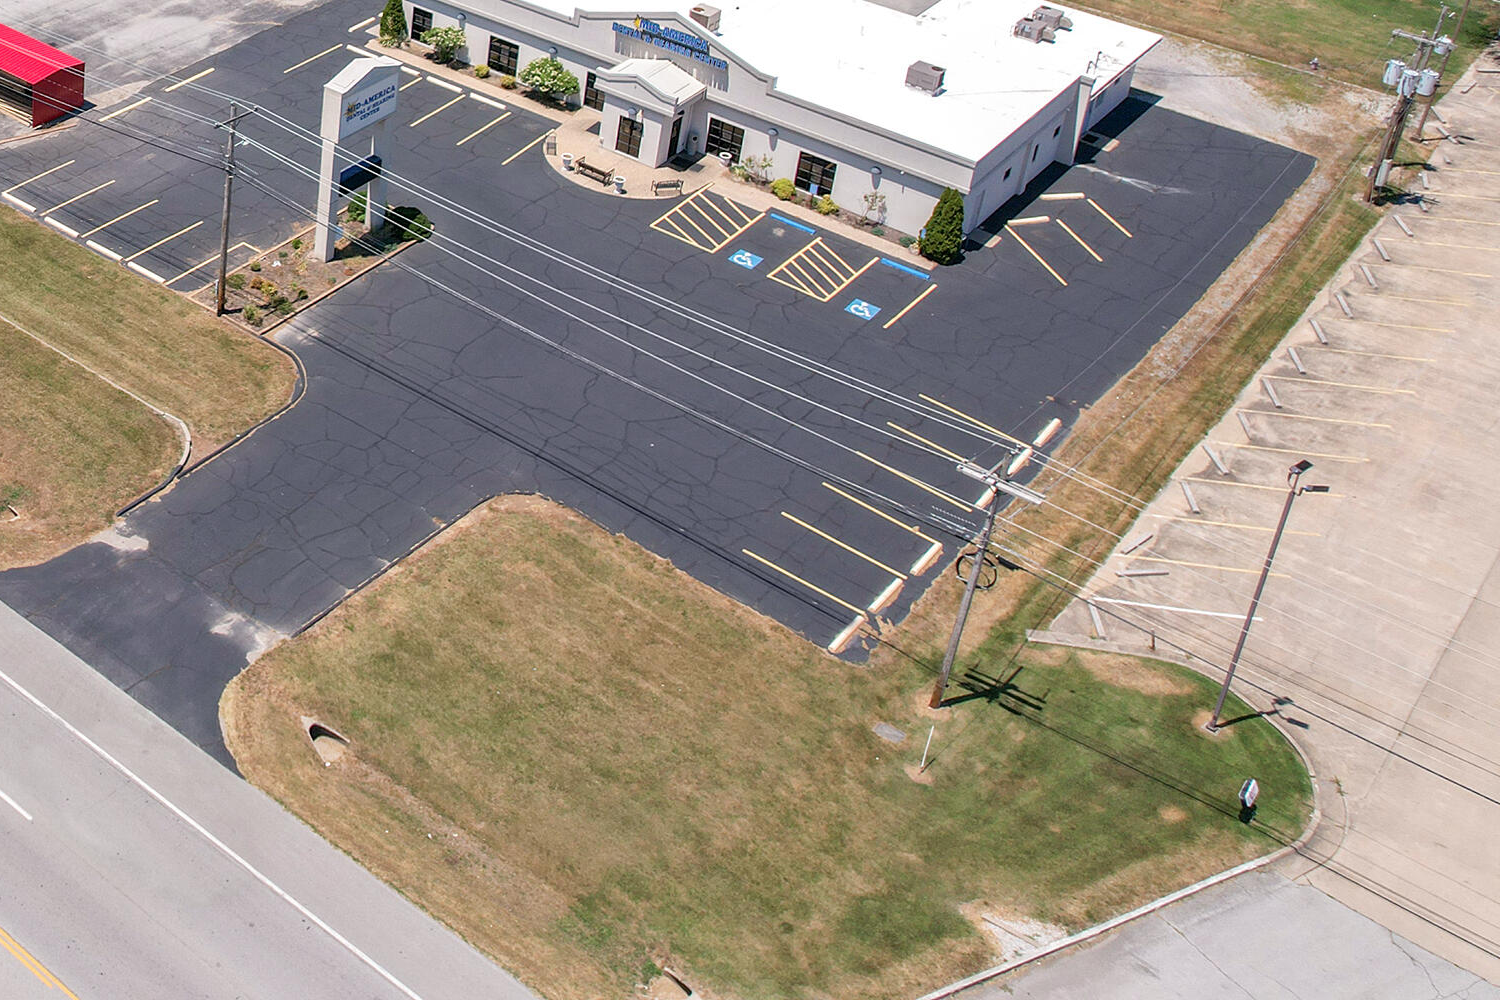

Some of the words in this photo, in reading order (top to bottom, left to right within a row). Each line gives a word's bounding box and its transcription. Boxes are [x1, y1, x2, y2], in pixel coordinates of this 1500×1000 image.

[612, 21, 642, 41] DENTAL
[644, 35, 652, 44] &
[654, 37, 692, 58] HEARING
[694, 51, 728, 70] CENTER
[639, 18, 709, 52] MID-AMERICA
[346, 107, 366, 122] DENTAL
[372, 92, 395, 109] HEARING
[347, 84, 396, 112] MID-AMERICA
[360, 106, 380, 120] CENTER
